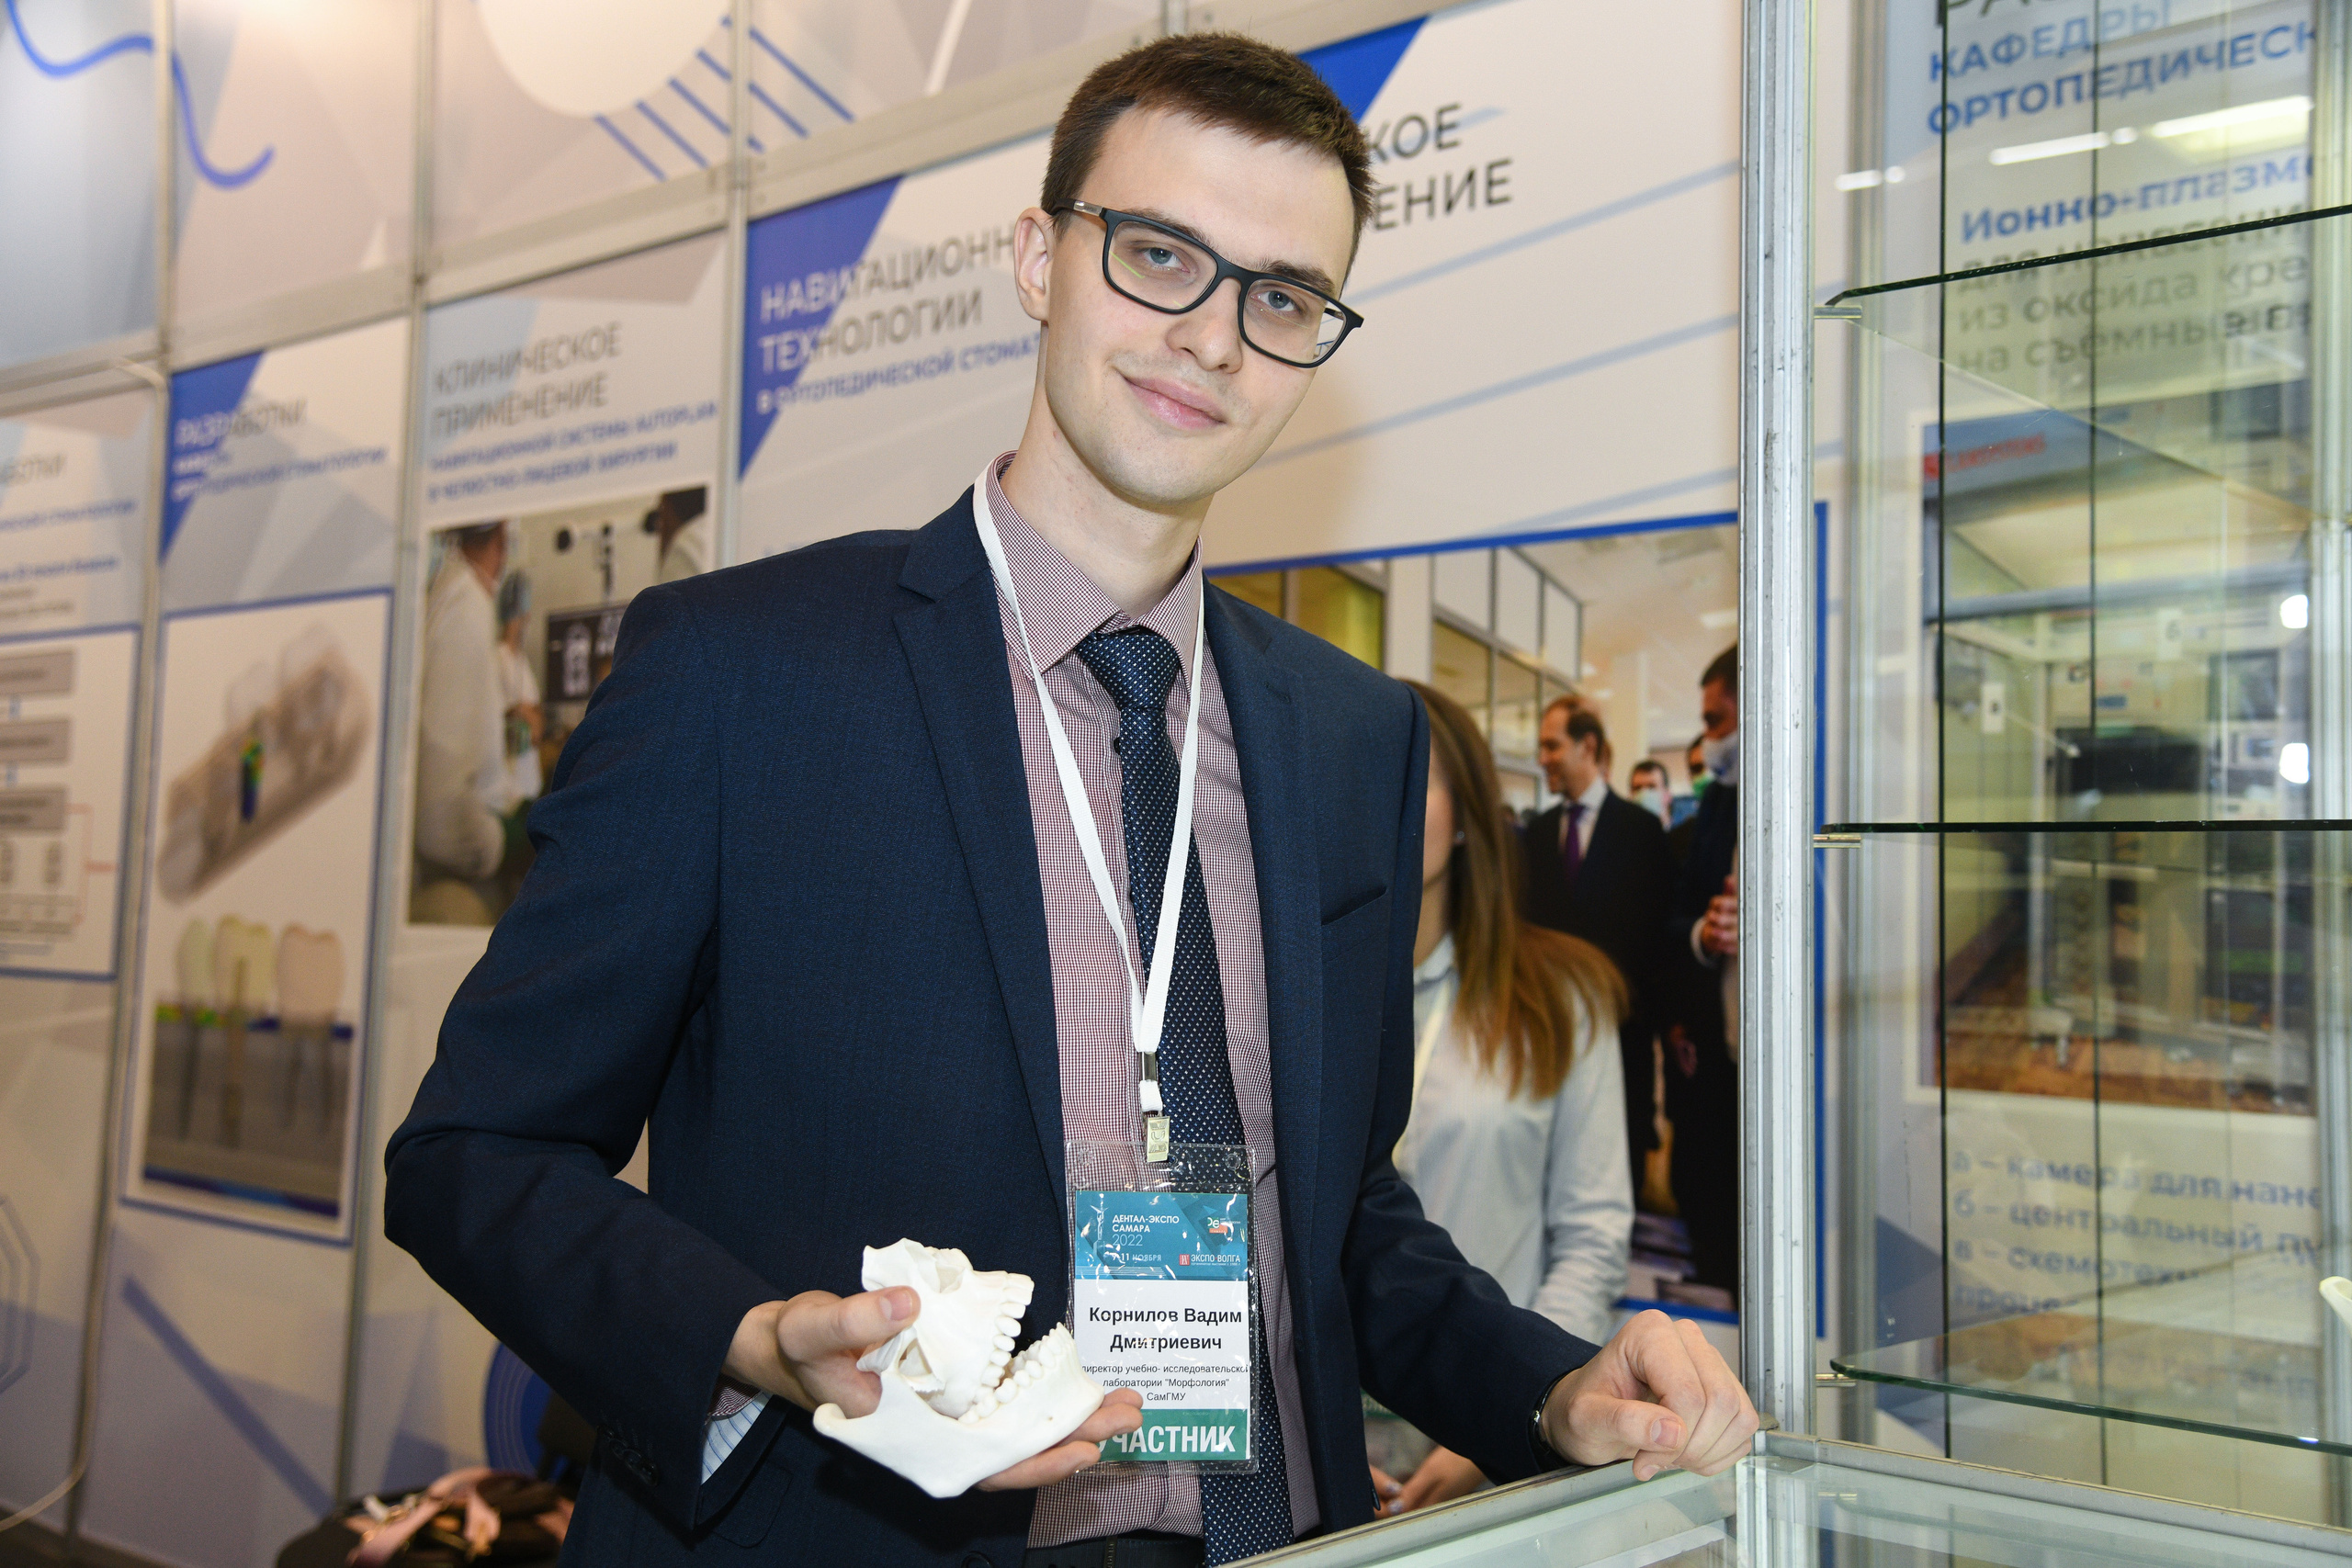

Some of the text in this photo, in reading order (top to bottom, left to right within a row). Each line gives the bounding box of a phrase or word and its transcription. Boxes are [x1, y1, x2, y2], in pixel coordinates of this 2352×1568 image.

[1930, 3, 2172, 83] КАФЕДРЫ
[1375, 157, 1512, 231] ЕНИЕ
[1961, 158, 2312, 244] Ионно-плазм
[1958, 301, 2010, 333] из
[2023, 272, 2199, 323] оксида
[757, 287, 982, 375] ТЕХНОЛОГИИ
[435, 321, 623, 395] КЛИНИЧЕСКОЕ
[1959, 347, 2010, 376] на
[431, 371, 610, 438] ПРИМЕНЕНИЕ
[2149, 1170, 2222, 1200] для
[1112, 1214, 1180, 1224] ДЕНТАЛ-ЭКСПО
[1112, 1224, 1150, 1233] САМАРА
[2010, 1204, 2263, 1252] центральный
[1112, 1234, 1143, 1247] 2022
[1132, 1253, 1162, 1262] НОЯБРЯ
[1090, 1307, 1241, 1325] Корнилов Вадим
[1110, 1335, 1222, 1352] Дмитриевич
[1102, 1378, 1229, 1388] лаборатории "Морфология"
[1147, 1393, 1186, 1401] СамГМУ
[1099, 1426, 1236, 1453] ЧАСТНИК
